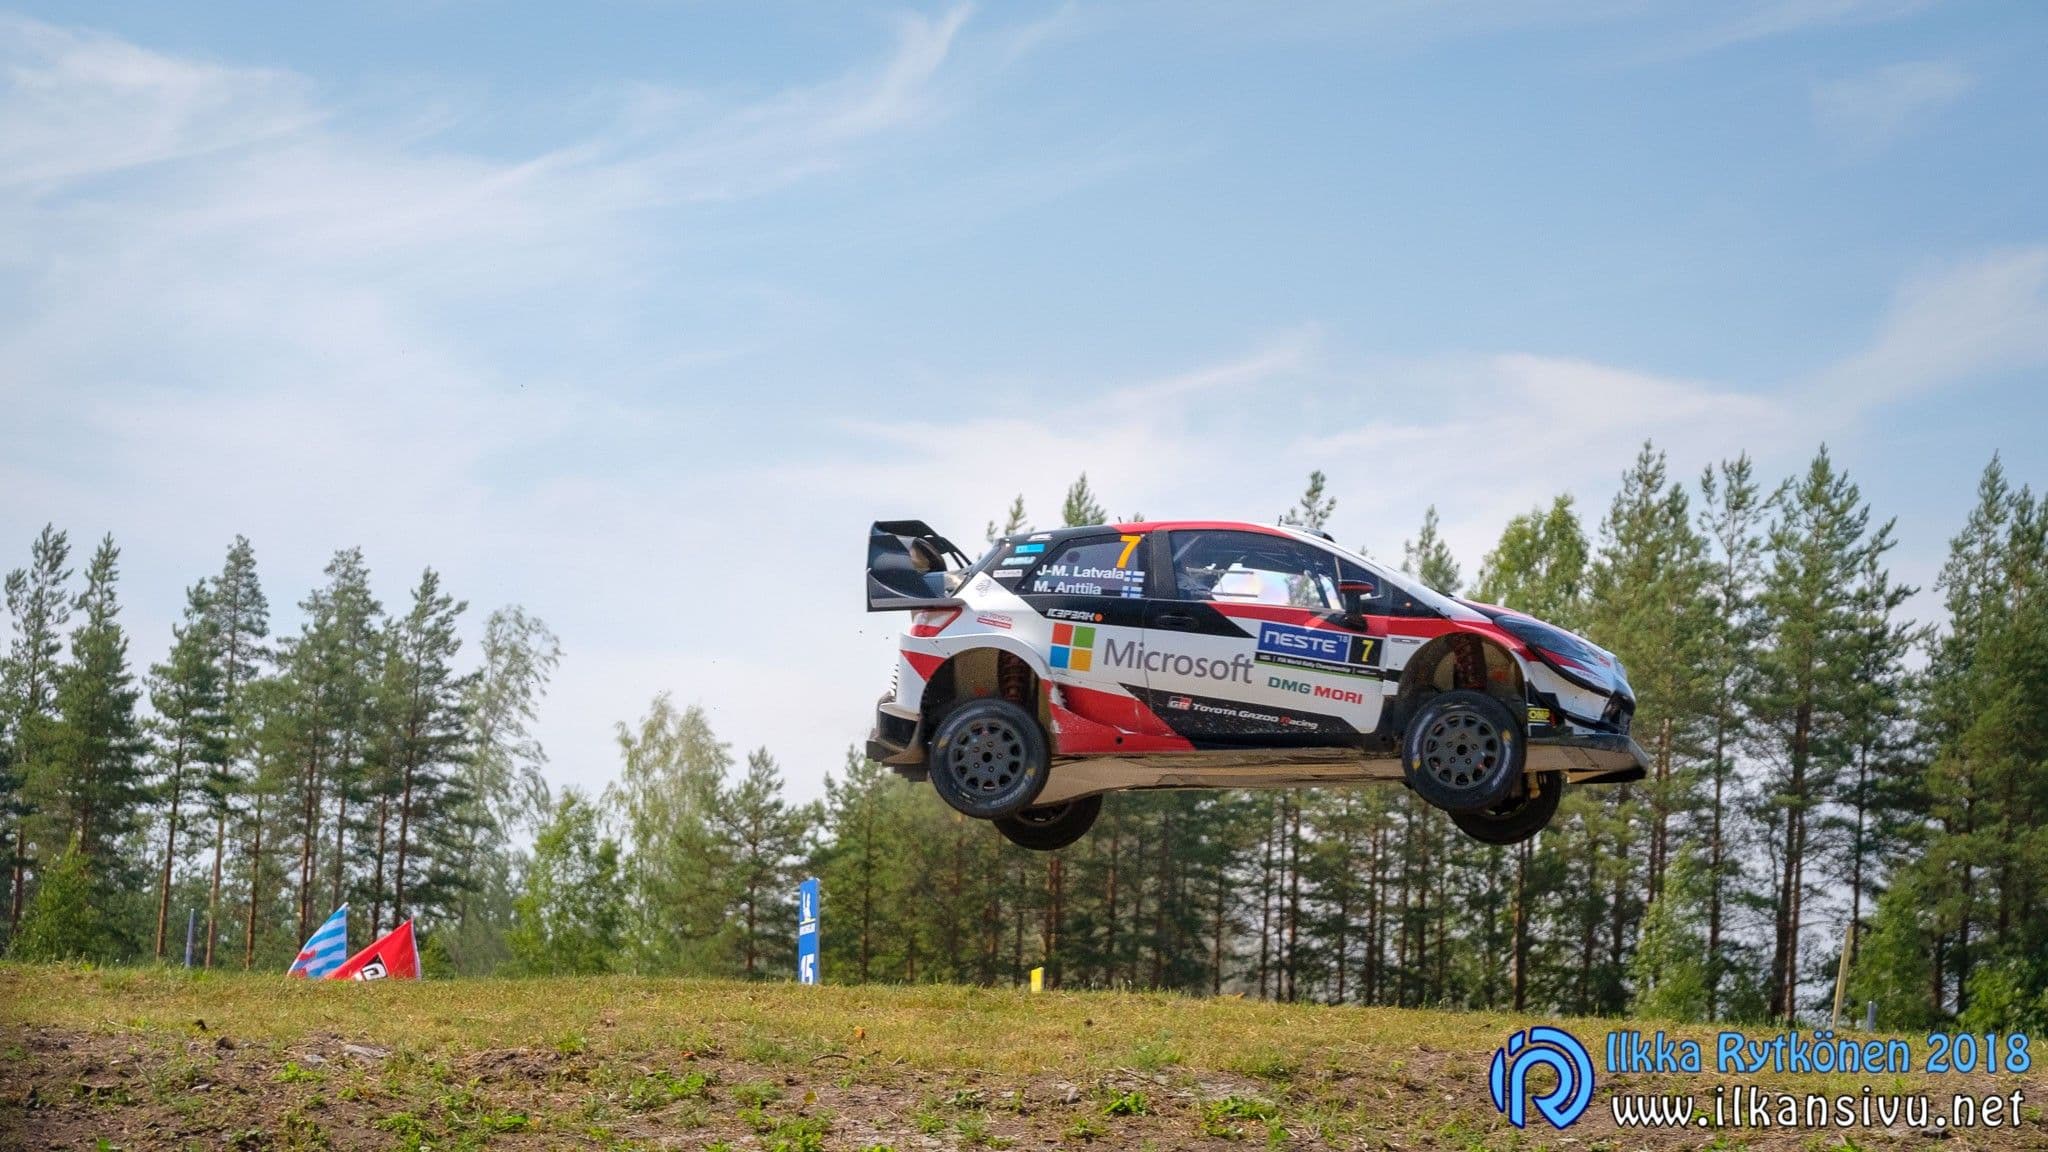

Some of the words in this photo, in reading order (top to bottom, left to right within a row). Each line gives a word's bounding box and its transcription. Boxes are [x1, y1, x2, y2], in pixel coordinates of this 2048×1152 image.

[1116, 535, 1142, 569] 7
[1036, 564, 1069, 577] J-M.
[1073, 565, 1125, 580] Latvala
[1033, 580, 1052, 593] M.
[1054, 581, 1102, 595] Anttila
[1264, 630, 1338, 654] NESTE
[1361, 639, 1375, 663] 7
[1103, 638, 1254, 685] Microsoft
[1268, 676, 1311, 694] DMG
[1314, 685, 1363, 705] MORI
[1192, 703, 1237, 716] TOYOTA
[1280, 715, 1319, 730] Racing
